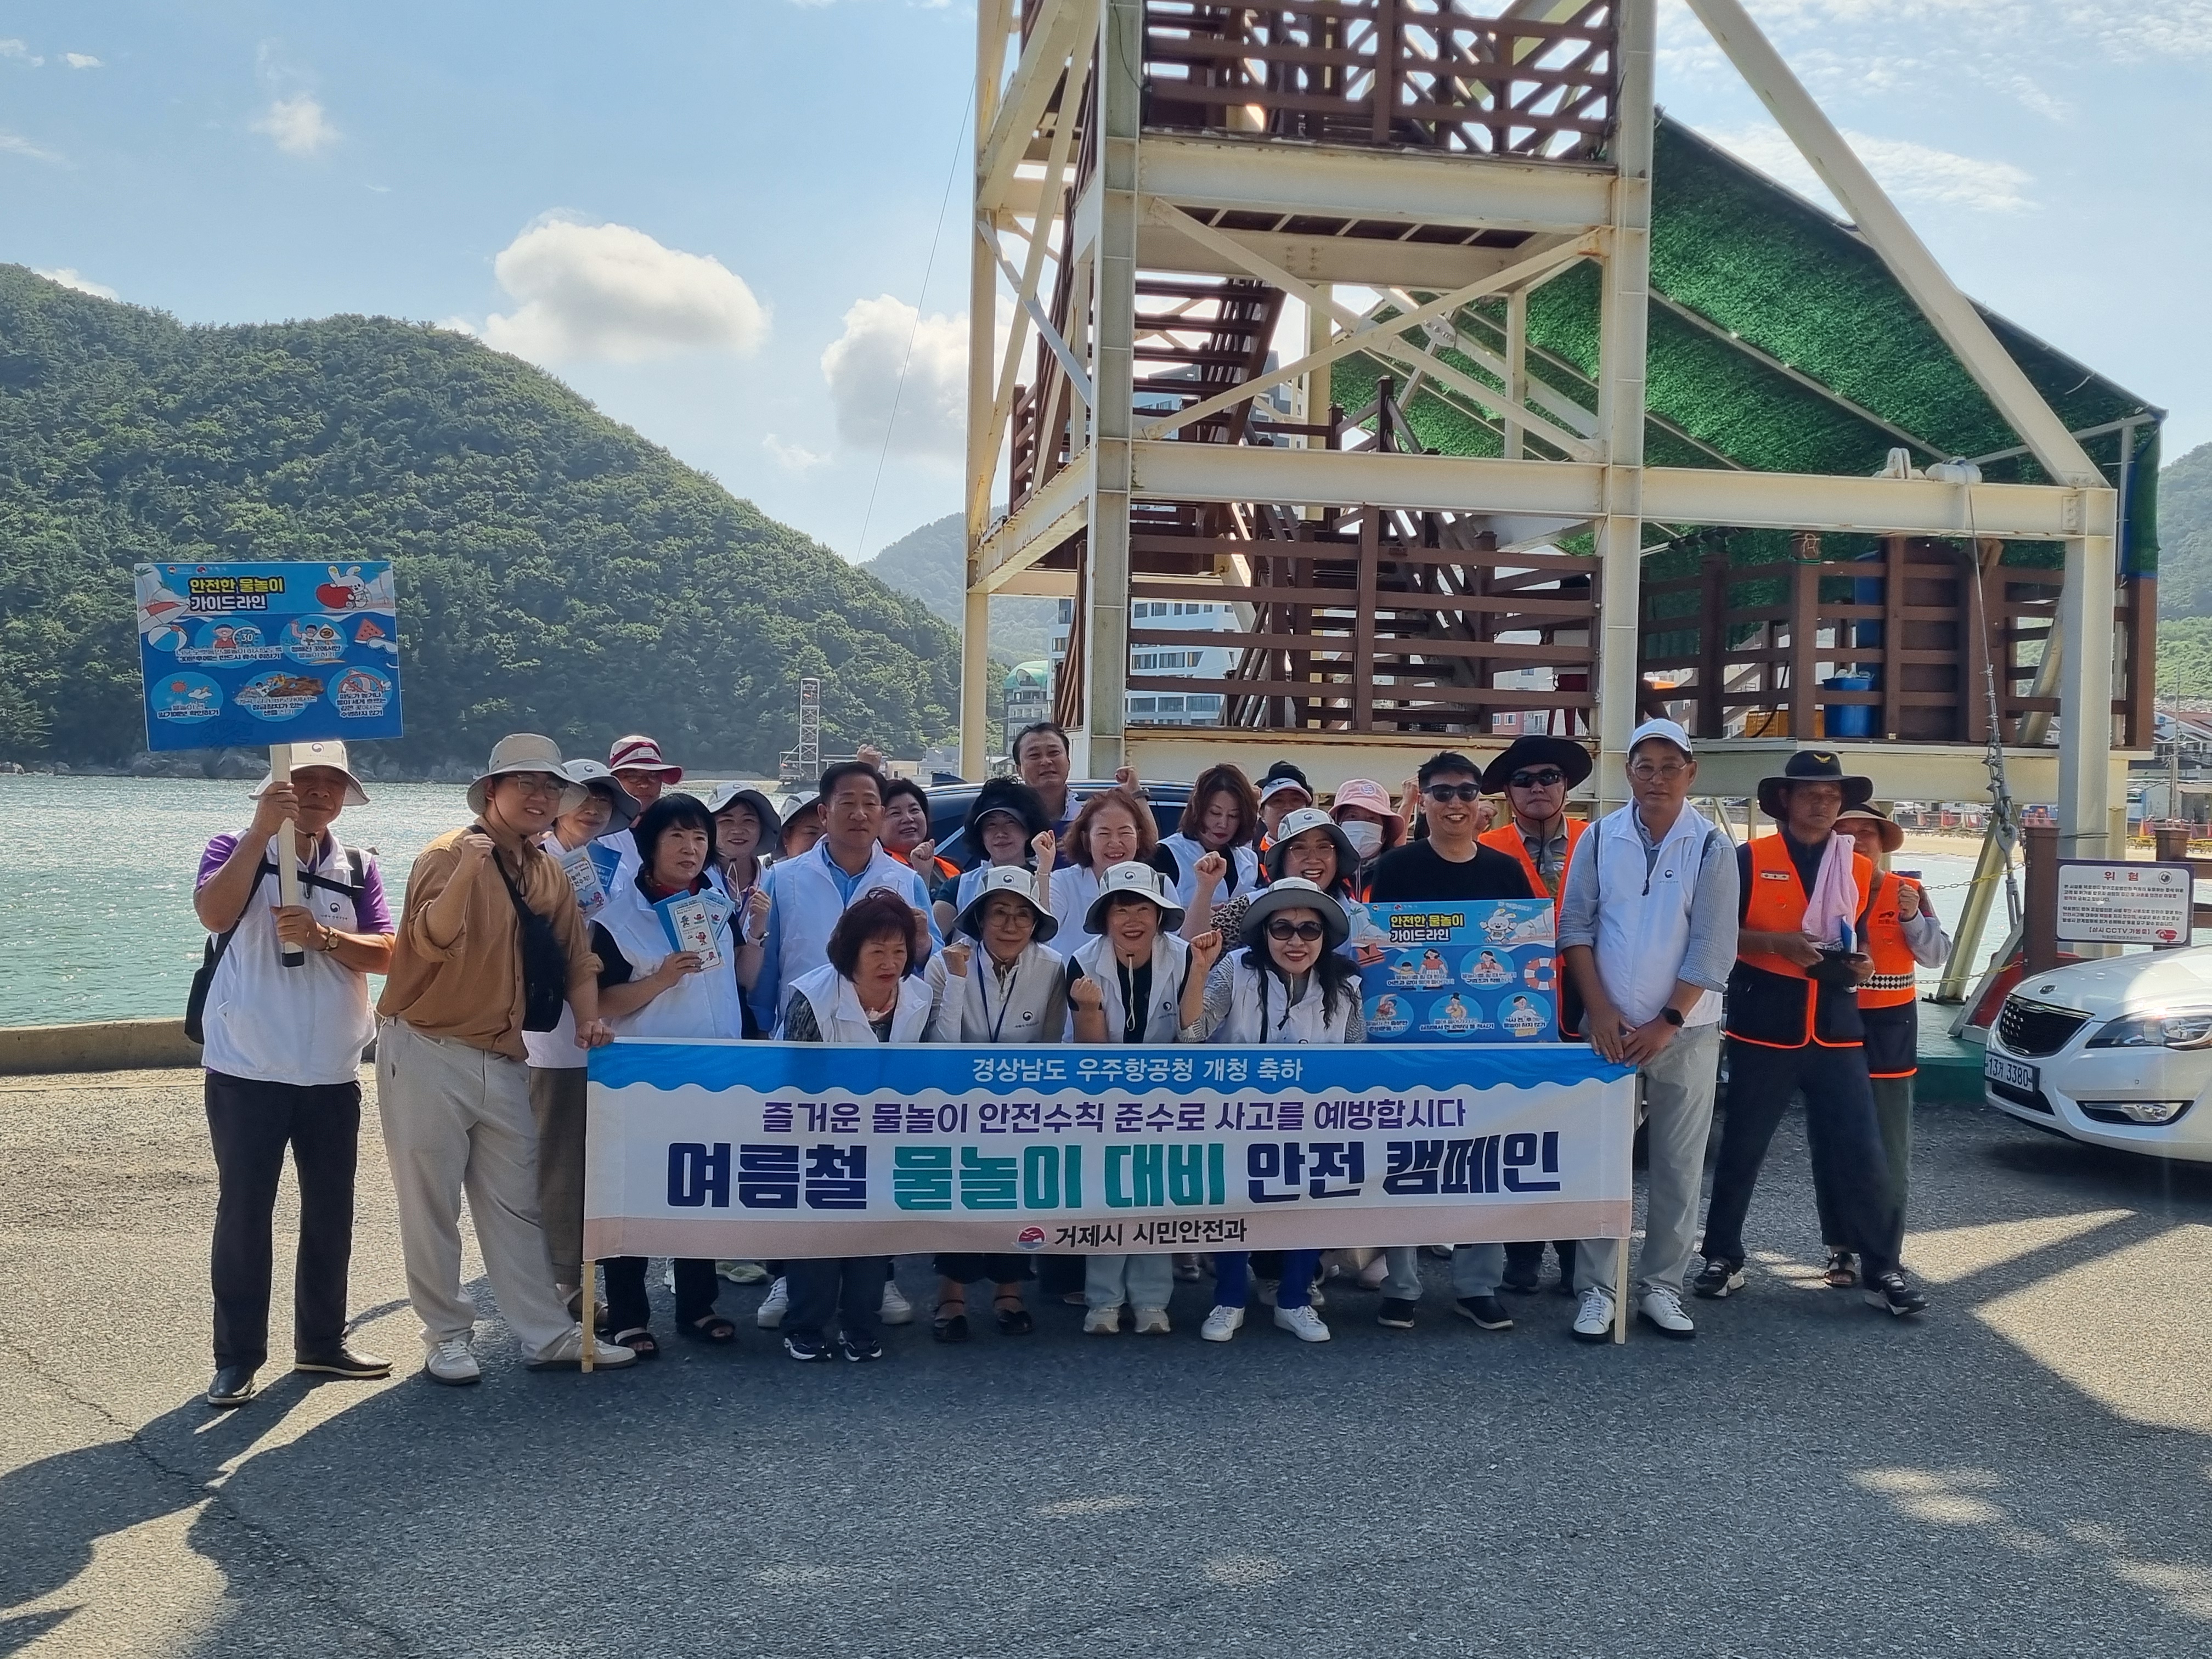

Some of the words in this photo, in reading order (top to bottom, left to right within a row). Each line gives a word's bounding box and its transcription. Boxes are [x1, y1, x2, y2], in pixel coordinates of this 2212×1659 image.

[189, 578, 236, 594] 안전한
[239, 578, 284, 593] 물놀이
[190, 595, 267, 610] 가이드라인
[241, 633, 254, 642] 30
[2104, 871, 2115, 881] 위
[2128, 872, 2139, 882] 험
[1390, 915, 1426, 928] 안전한
[1428, 913, 1464, 927] 물놀이
[1391, 928, 1450, 942] 가이드라인
[972, 1058, 1067, 1082] 경상남도
[1076, 1058, 1193, 1082] 우주항공청
[1203, 1058, 1248, 1082] 개청
[1257, 1058, 1303, 1081] 축하
[2006, 1063, 2029, 1087] 3380
[763, 1102, 861, 1133] 즐거운
[872, 1103, 968, 1133] 물놀이
[978, 1102, 1104, 1133] 안전수칙
[1114, 1103, 1206, 1133] 준수로
[1214, 1102, 1305, 1131] 사고를
[1314, 1098, 1466, 1130] 예방합시다
[667, 1142, 868, 1210] 여름철
[892, 1144, 1082, 1211] 물놀이
[1104, 1143, 1226, 1208] 대비
[1247, 1141, 1365, 1204] 안전
[1383, 1131, 1561, 1195] 캠페인
[1053, 1223, 1124, 1248] 거제시
[1132, 1218, 1248, 1245] 시민안전과
